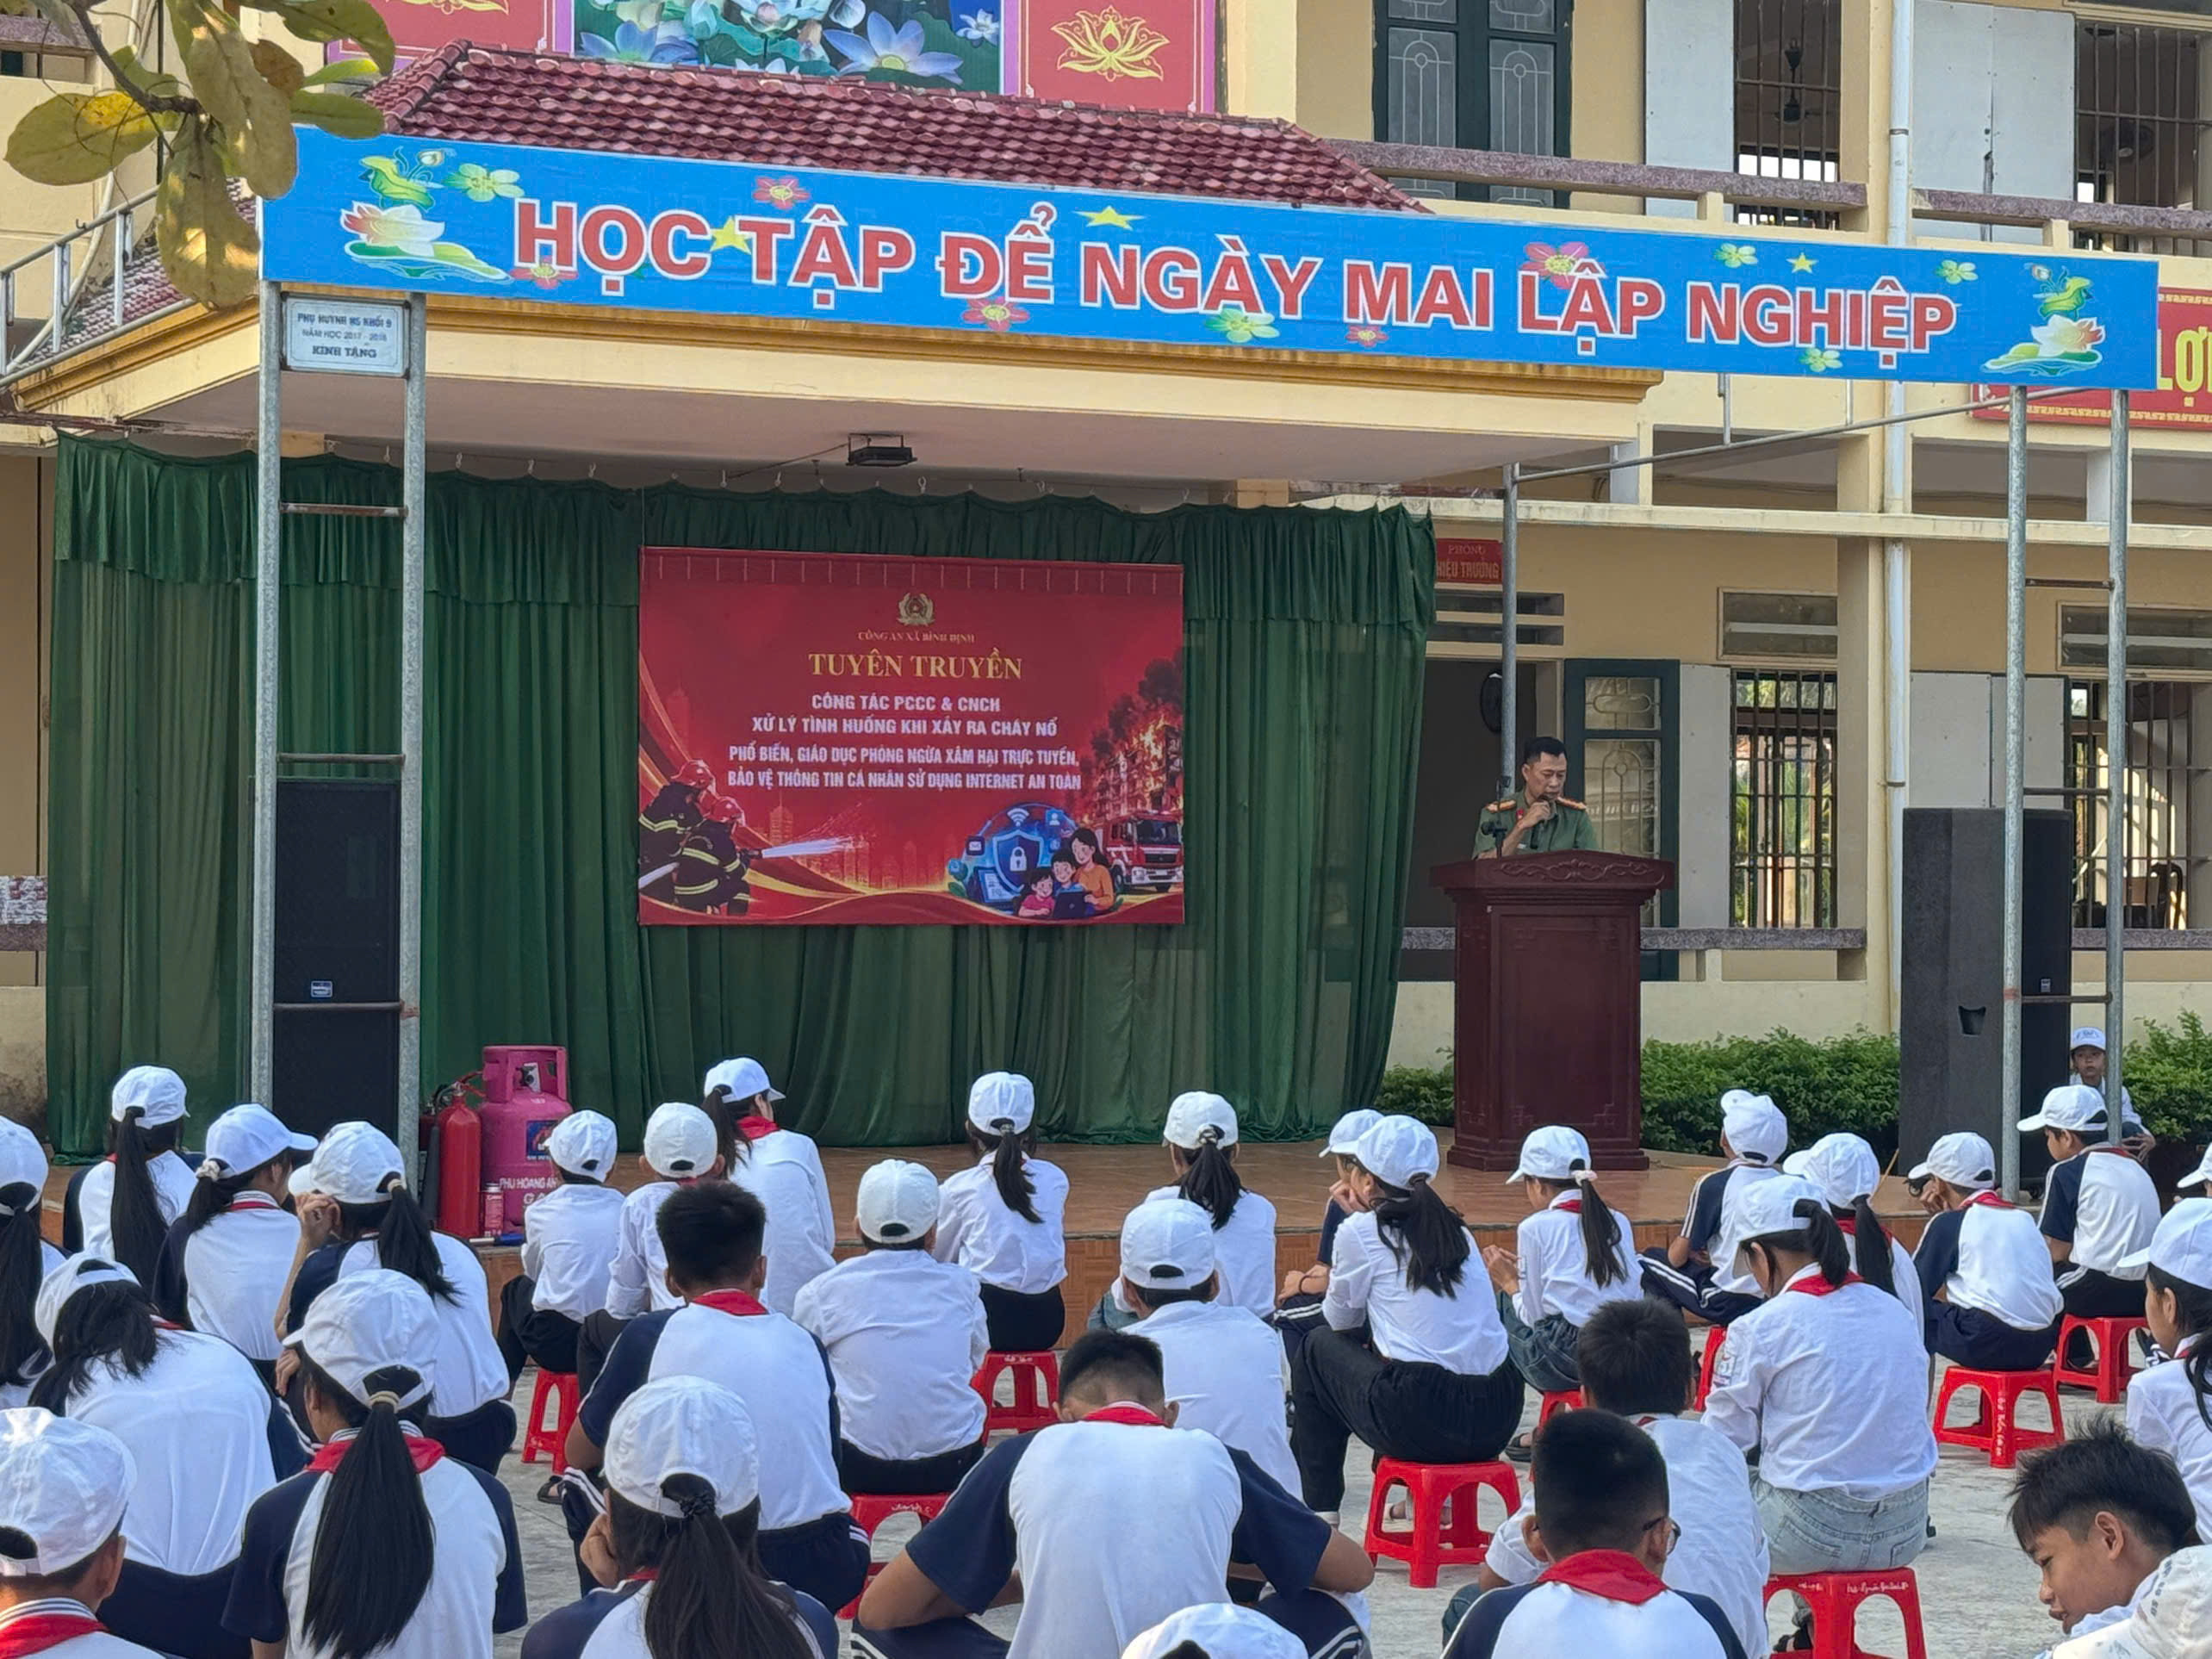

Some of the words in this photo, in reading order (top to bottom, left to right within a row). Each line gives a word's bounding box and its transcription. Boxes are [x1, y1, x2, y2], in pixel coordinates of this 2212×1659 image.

[516, 198, 711, 296] HỌC
[735, 204, 916, 309] TẬP
[935, 202, 1058, 303] ĐỂ
[1080, 233, 1324, 320] NGÀY
[1342, 259, 1494, 331] MAI
[1517, 258, 1666, 356] LẬP
[1687, 276, 1957, 370] NGHIỆP
[297, 313, 315, 326] PHỤ
[386, 320, 392, 328] 9
[2156, 325, 2212, 407] LỢ
[858, 628, 889, 641] CÔNG
[890, 632, 904, 641] AN
[906, 630, 921, 642] XÃ
[923, 631, 948, 642] BÌNH
[809, 648, 903, 677] TUYÊN
[910, 647, 1023, 680] TRUYỀN
[811, 692, 855, 709] CÔNG
[860, 693, 889, 710] TÁC
[894, 695, 935, 711] PCCC
[941, 697, 953, 711] &
[957, 697, 1000, 712] CNCH
[752, 712, 775, 731] XỬ
[779, 715, 797, 732] LÝ
[802, 715, 837, 733] TÌNH
[842, 714, 897, 734] HUỐNG
[901, 719, 927, 734] KHI
[966, 720, 987, 736] RA
[991, 718, 1031, 736] CHÁY
[759, 742, 793, 764] BIẾN,
[797, 743, 827, 763] GIÁO
[831, 748, 857, 766] DỤC
[861, 744, 904, 764] PHÒNG
[907, 745, 941, 764] NGỪA
[978, 749, 998, 767] HẠI
[1002, 748, 1034, 767] TRỰC
[728, 765, 754, 786] BẢO
[757, 768, 773, 790] VỆ
[777, 768, 819, 787] THÔNG
[823, 772, 843, 787] TIN
[847, 769, 865, 787] CÁ
[907, 767, 927, 788] SỬ
[928, 772, 962, 792] DỤNG
[966, 773, 1024, 789] INTERNET
[1028, 774, 1046, 790] AN
[1049, 771, 1082, 791] TOÀN
